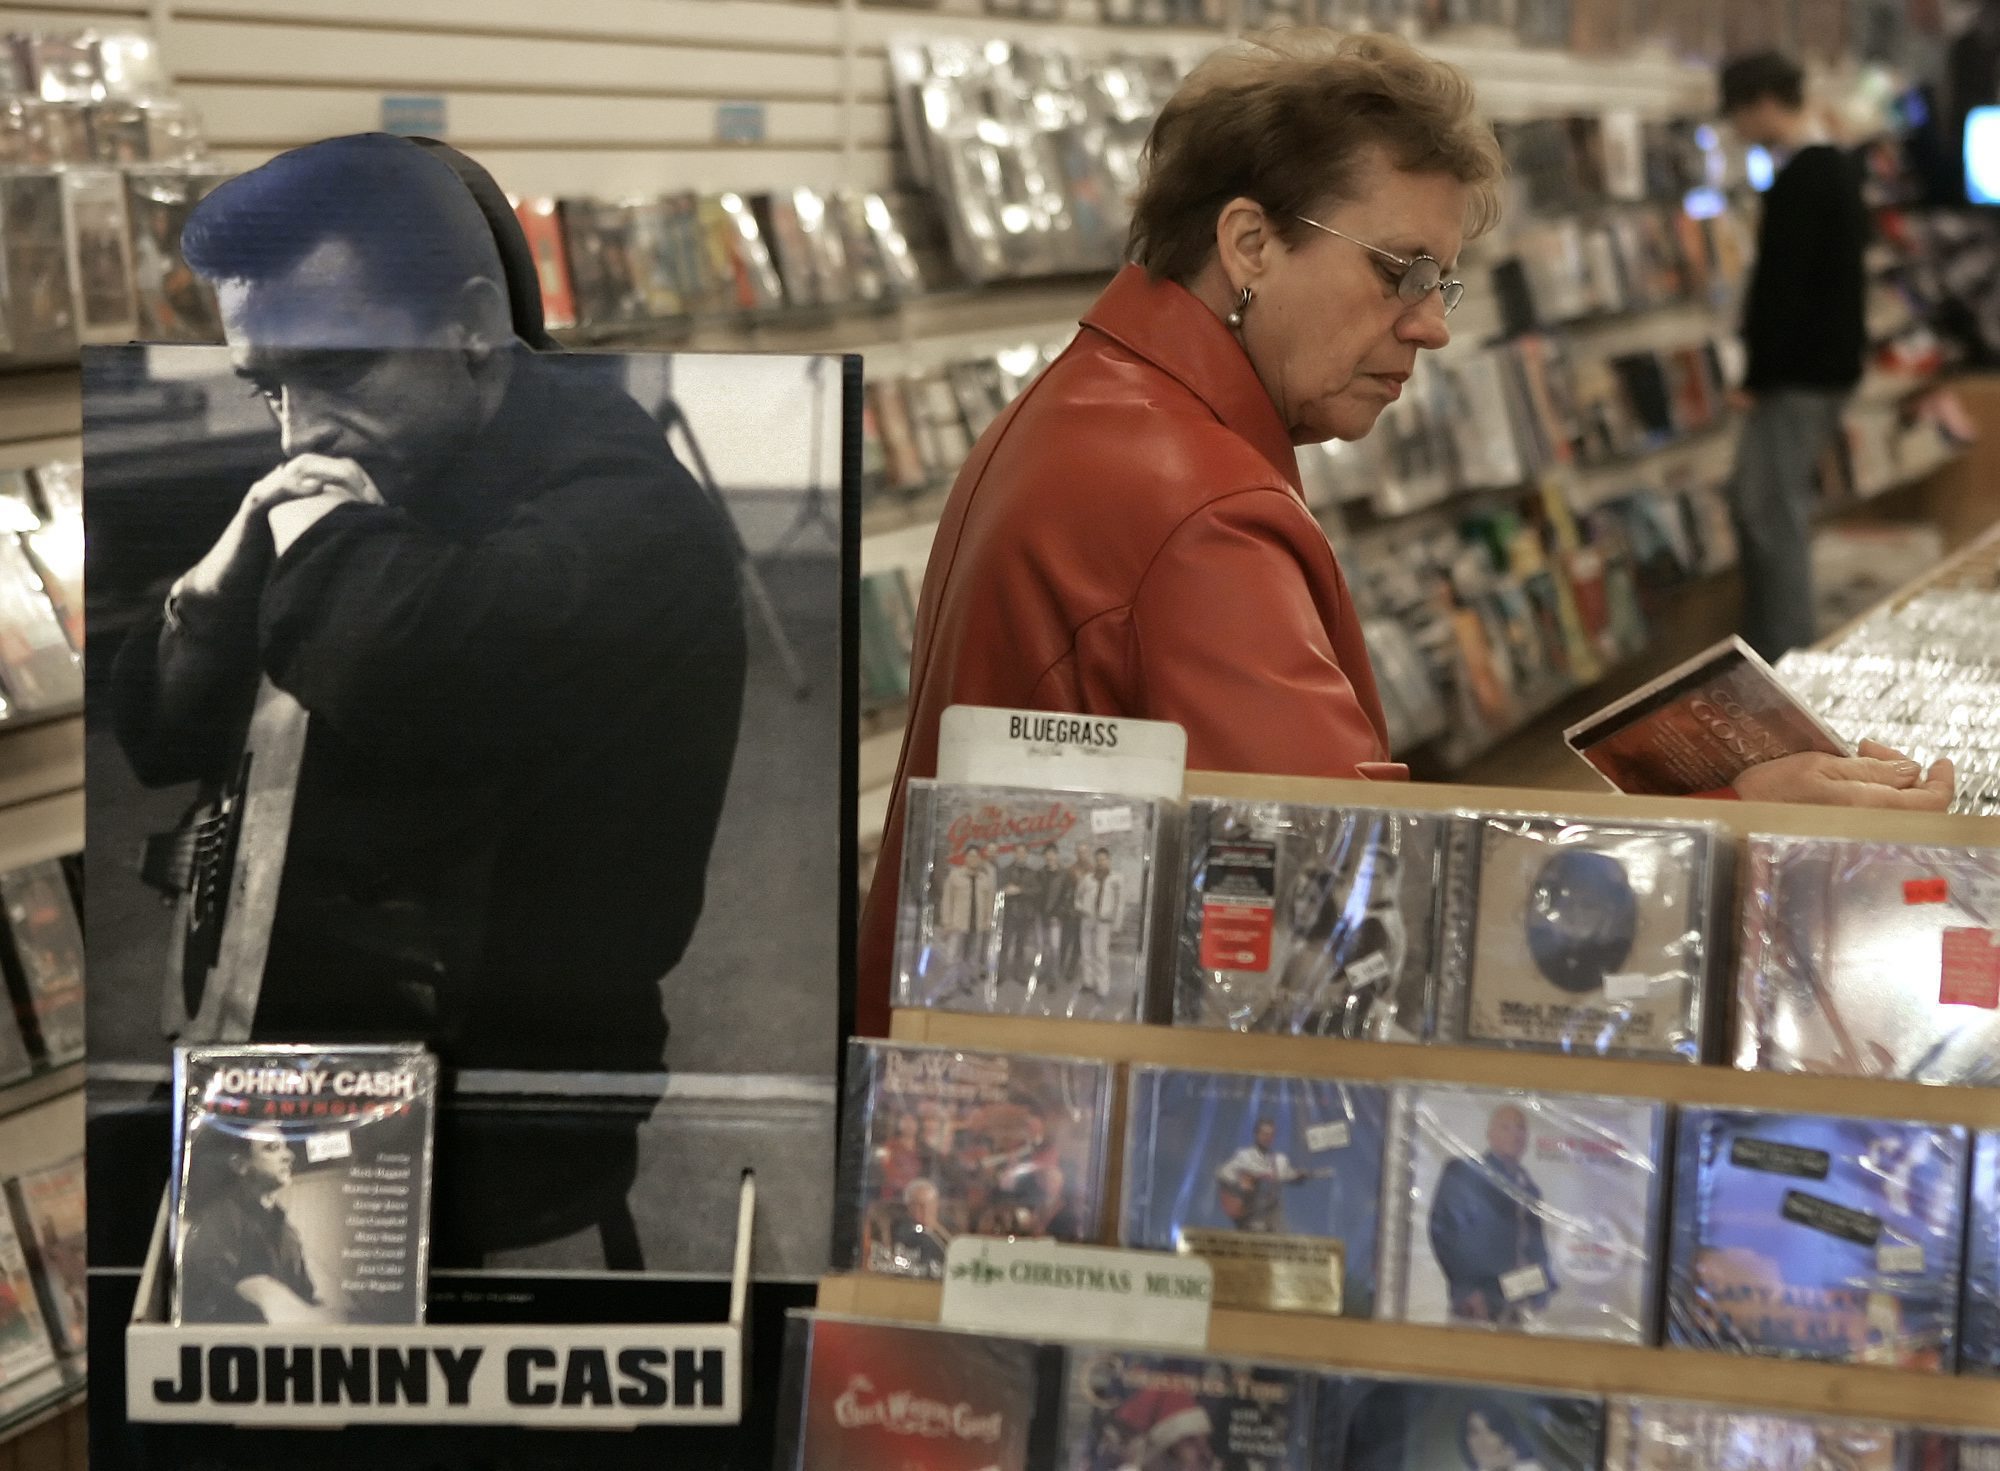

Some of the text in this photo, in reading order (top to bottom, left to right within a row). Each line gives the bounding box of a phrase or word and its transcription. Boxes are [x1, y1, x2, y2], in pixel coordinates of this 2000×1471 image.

[1009, 714, 1119, 748] BLUEGRASS
[207, 1067, 414, 1098] JOHNNY CASH
[1009, 1259, 1210, 1300] CHRISTMAS MUSIC
[153, 1346, 724, 1407] JOHNNY CASH
